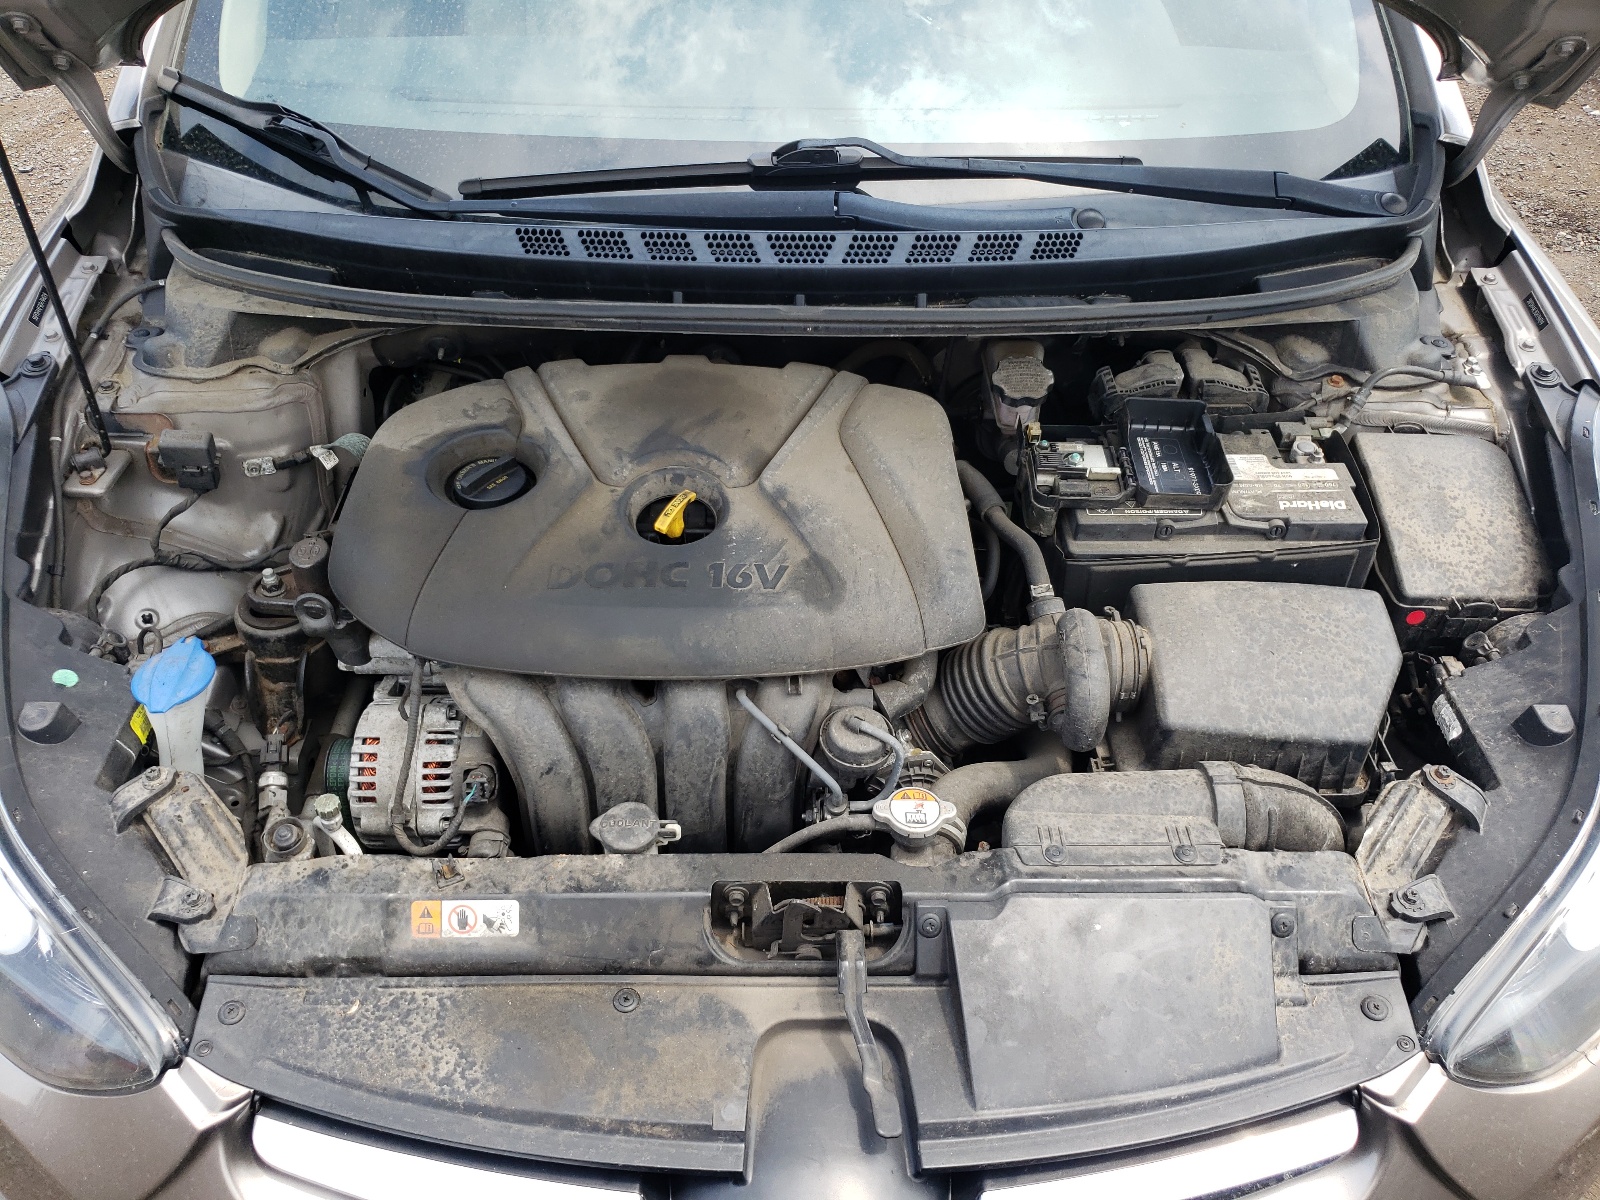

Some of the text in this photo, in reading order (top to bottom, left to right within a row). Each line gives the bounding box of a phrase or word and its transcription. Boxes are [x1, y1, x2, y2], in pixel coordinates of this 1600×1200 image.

[1172, 462, 1181, 473] ALT
[1278, 500, 1347, 510] DieHard
[547, 561, 790, 591] DOHC 16V
[599, 819, 657, 829] COOLANT
